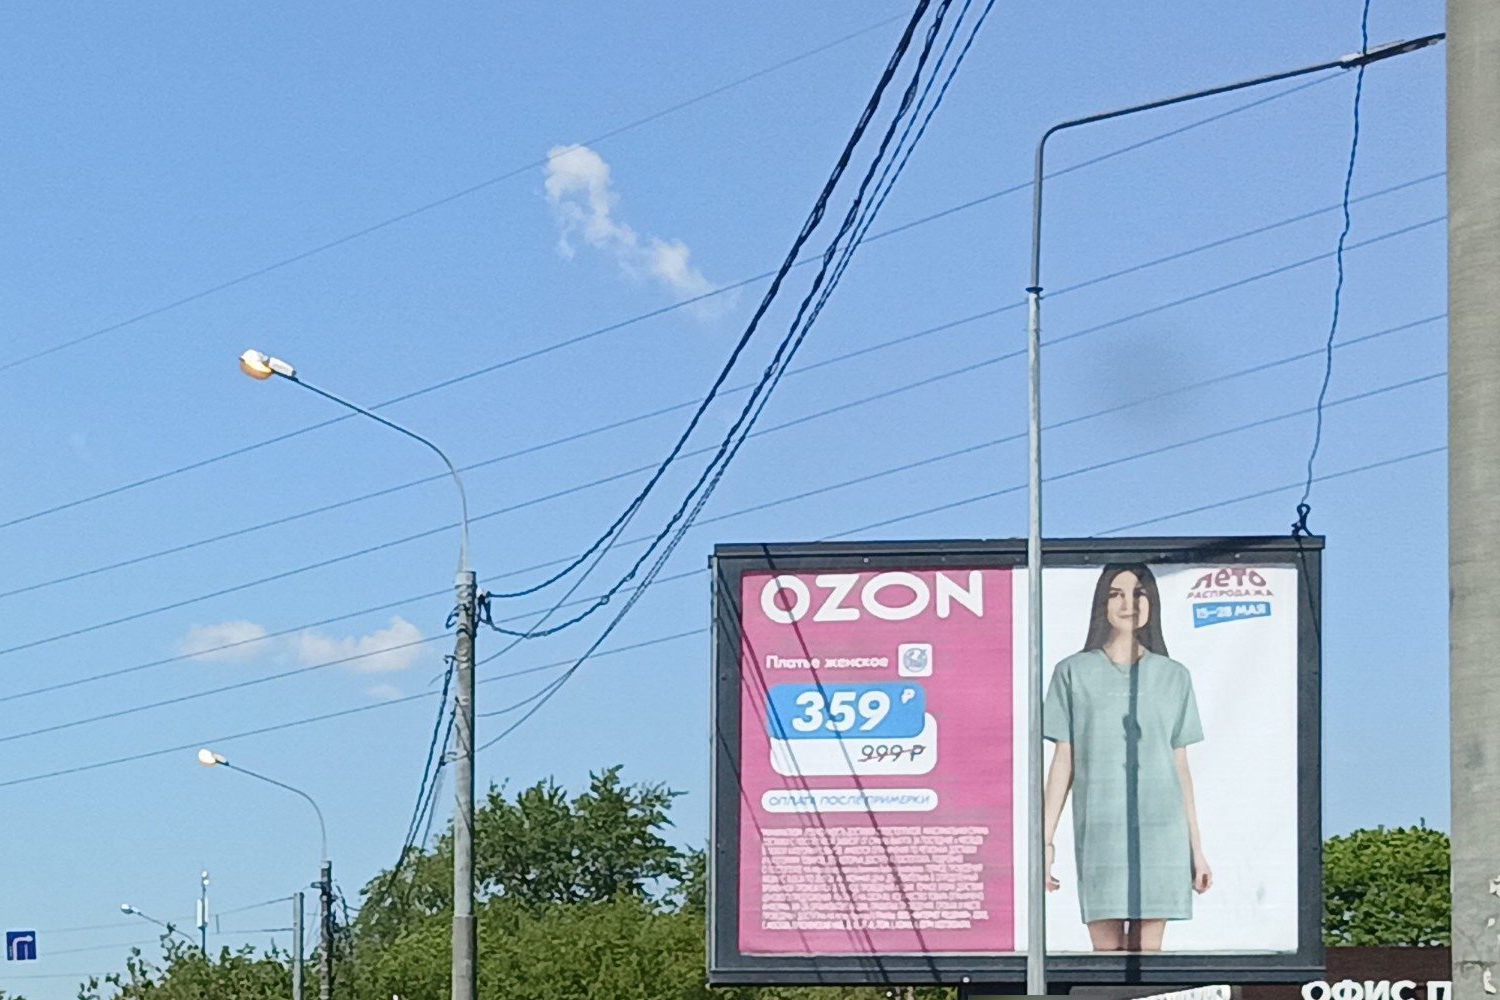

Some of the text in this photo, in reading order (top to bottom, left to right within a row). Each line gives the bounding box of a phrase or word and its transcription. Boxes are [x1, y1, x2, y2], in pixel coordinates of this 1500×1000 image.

[761, 570, 983, 624] OZON
[765, 655, 820, 669] Платье
[792, 690, 891, 732] 359
[861, 744, 903, 762] 999
